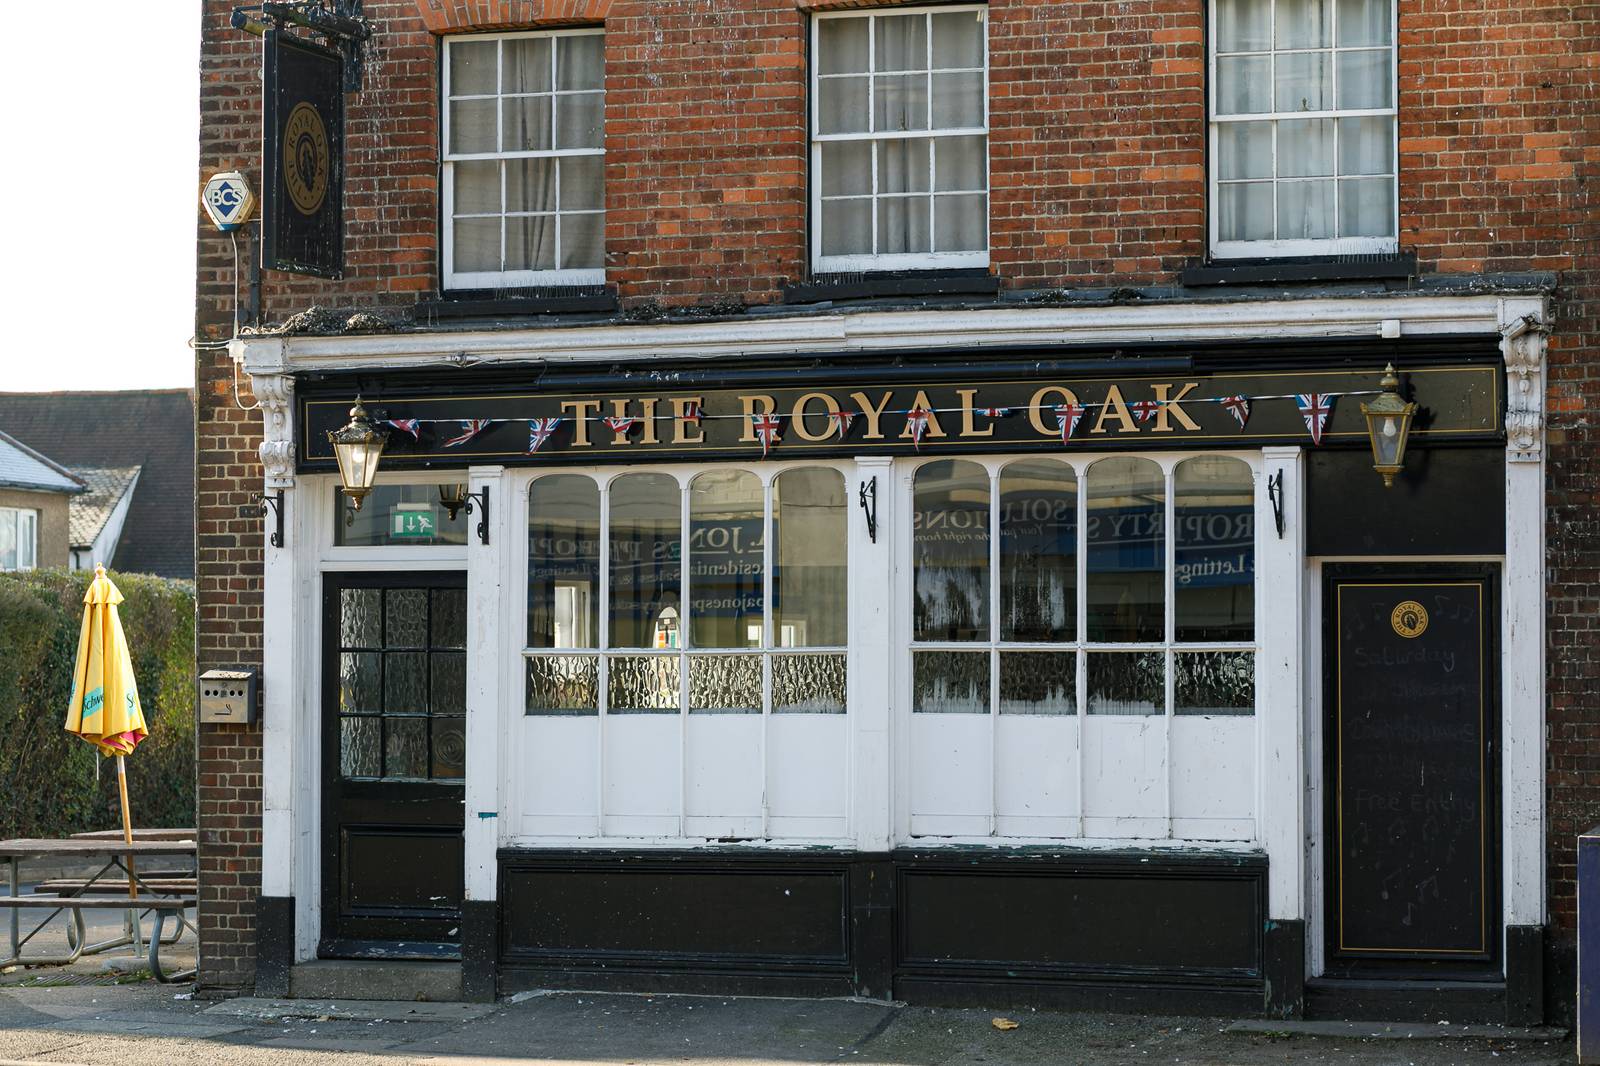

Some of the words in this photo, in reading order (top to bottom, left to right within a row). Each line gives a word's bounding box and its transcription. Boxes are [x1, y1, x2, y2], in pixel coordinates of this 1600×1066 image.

[210, 188, 243, 207] BCS
[561, 396, 705, 447] THE
[738, 388, 994, 443] ROYAL
[1028, 382, 1202, 437] OAK
[1353, 646, 1456, 673] Saturday
